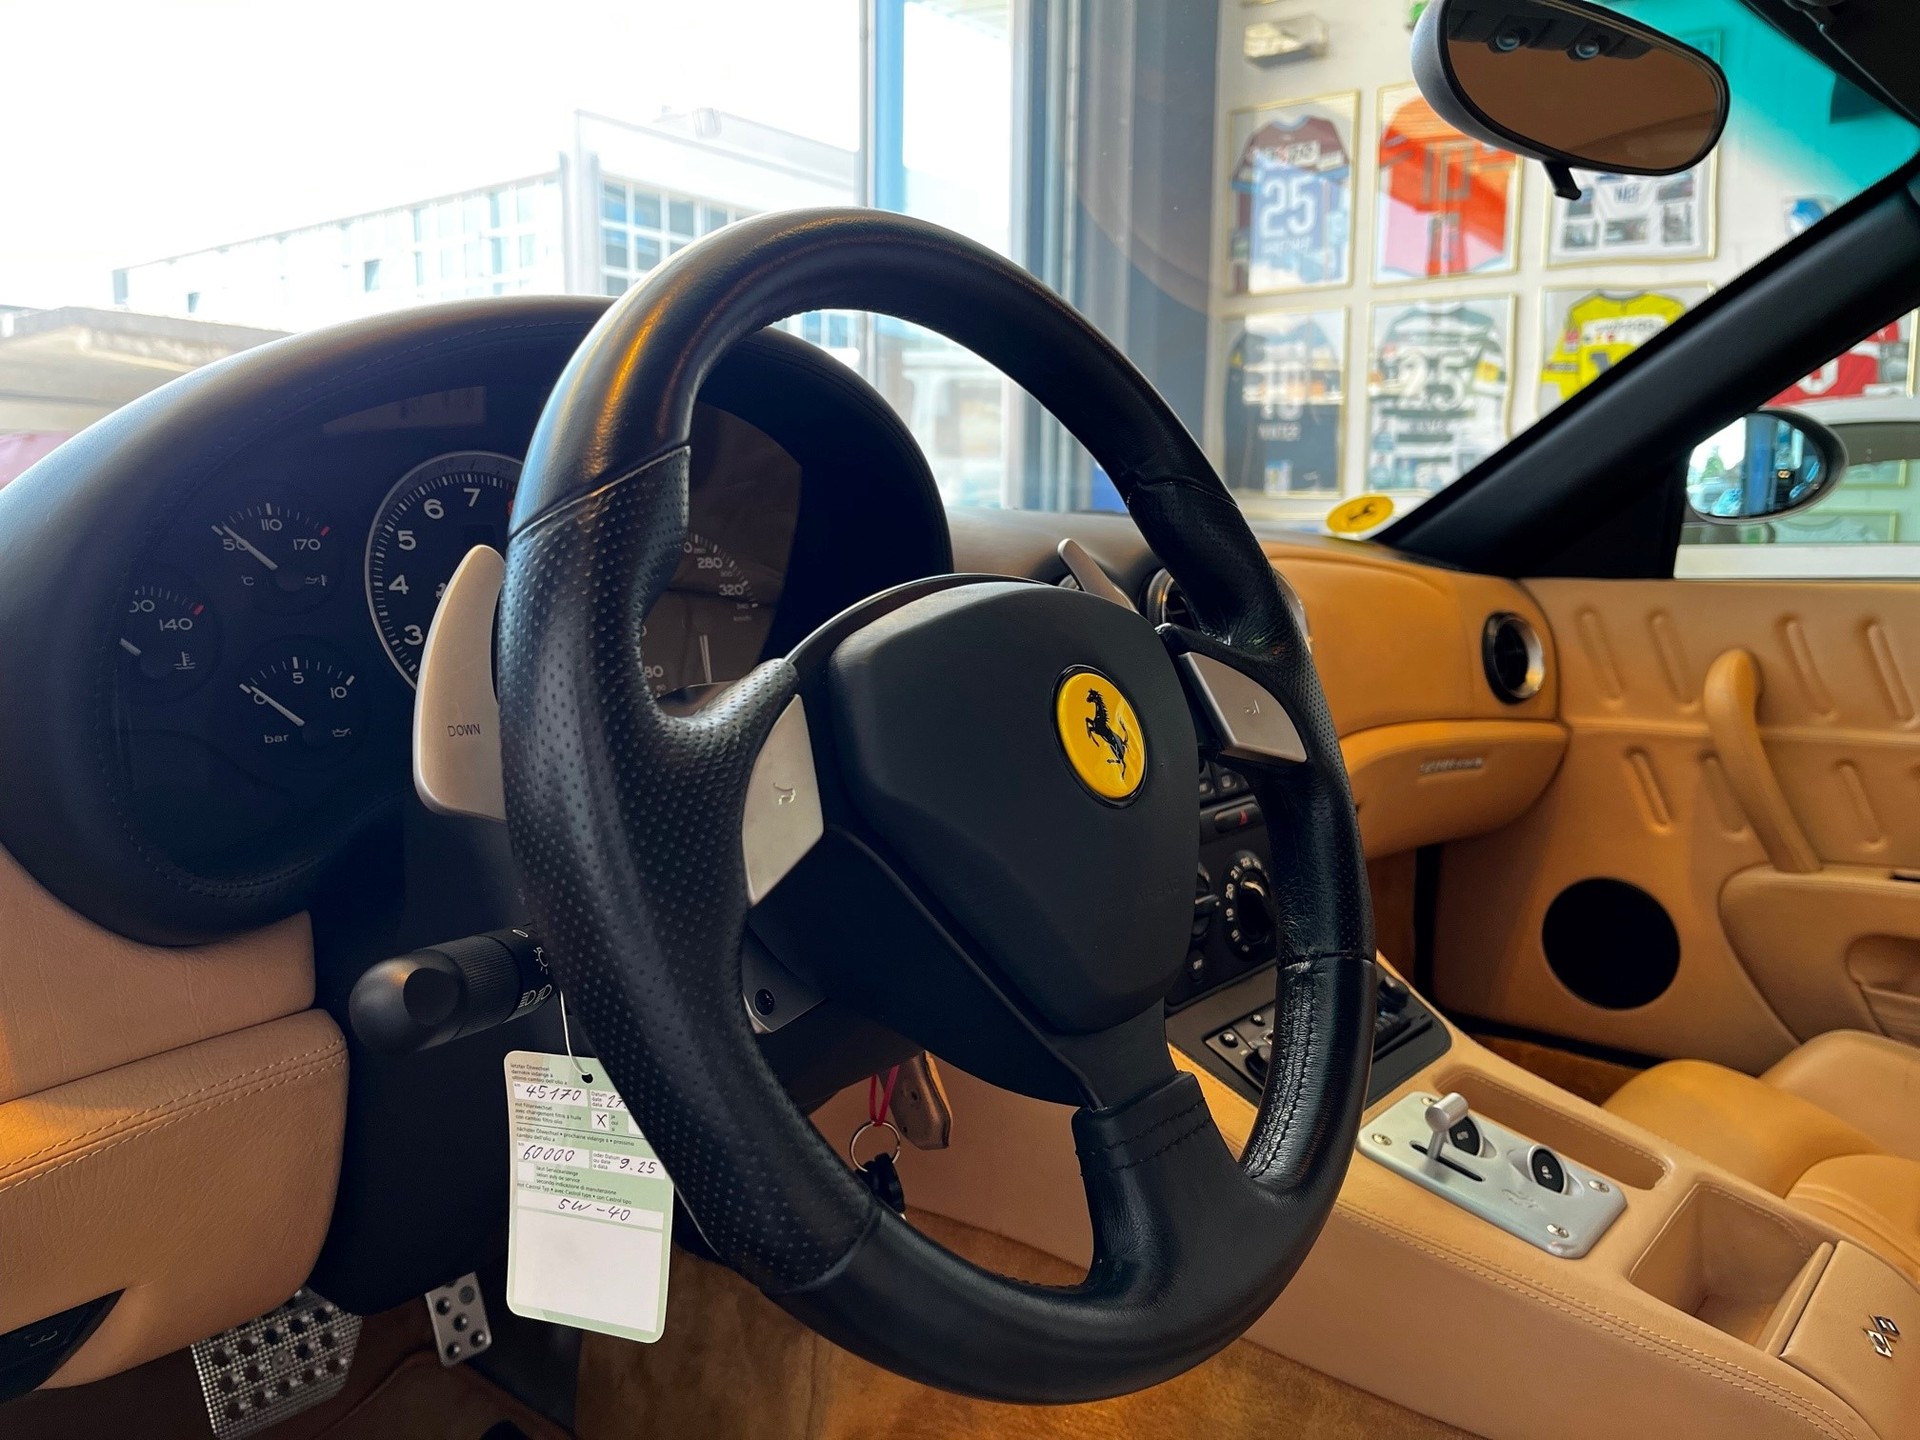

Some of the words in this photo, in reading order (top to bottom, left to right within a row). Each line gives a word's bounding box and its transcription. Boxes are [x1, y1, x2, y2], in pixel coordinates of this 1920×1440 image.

[1260, 174, 1319, 239] 25
[464, 487, 480, 507] 7
[424, 498, 444, 520] 6
[261, 518, 282, 531] 110
[222, 538, 248, 551] 50
[293, 538, 321, 551] 170
[398, 530, 416, 550] 5
[697, 557, 722, 568] 280
[388, 574, 408, 594] 4
[719, 584, 744, 596] 320
[159, 618, 193, 632] 140
[404, 624, 424, 646] 3
[292, 672, 304, 684] 5
[330, 686, 348, 699] 10
[447, 724, 481, 737] DOWN
[264, 734, 289, 744] bar
[1226, 884, 1235, 900] 20
[526, 1084, 582, 1101] 45170
[596, 1114, 607, 1128] X
[523, 1144, 575, 1162] 60000
